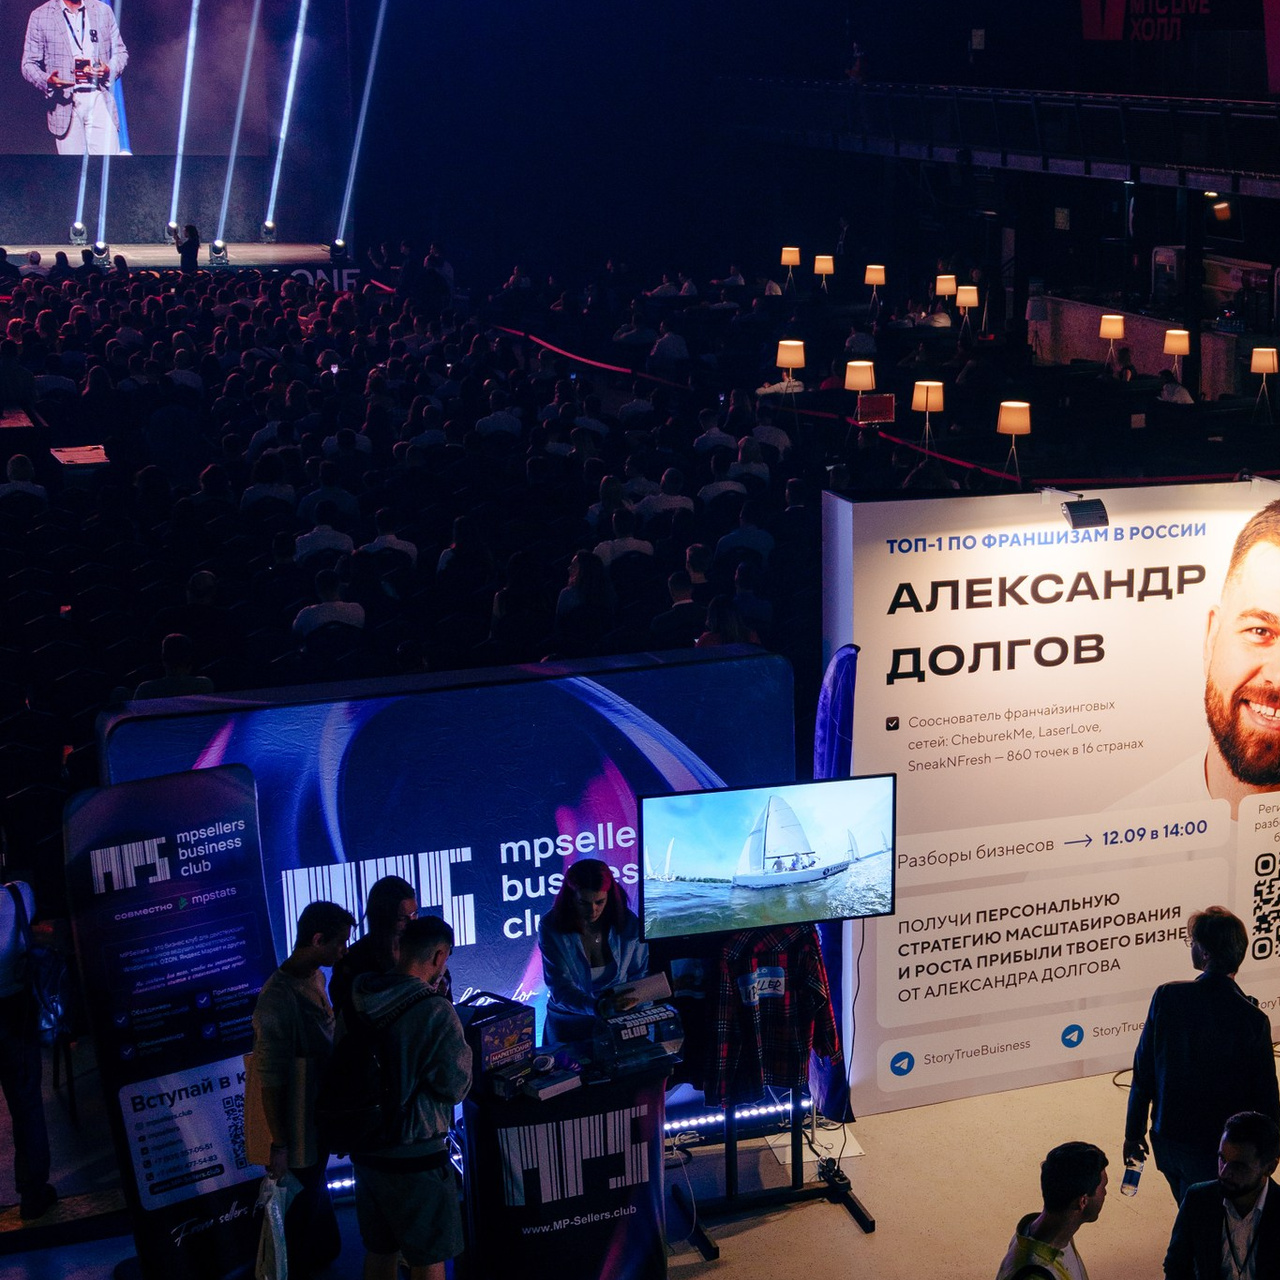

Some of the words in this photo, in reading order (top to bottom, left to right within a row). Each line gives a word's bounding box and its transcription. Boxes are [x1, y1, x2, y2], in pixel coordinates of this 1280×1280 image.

[1130, 16, 1182, 41] ХОЛЛ
[886, 536, 943, 555] ТОП-1
[948, 535, 977, 551] ПО
[981, 528, 1108, 549] ФРАНШИЗАМ
[1114, 526, 1125, 541] В
[1129, 522, 1207, 540] РОССИИ
[886, 564, 1207, 616] АЛЕКСАНДР
[886, 633, 1107, 686] ДОЛГОВ
[908, 711, 1002, 730] Сооснователь
[1003, 700, 1116, 723] франчайзинговых
[907, 735, 949, 751] сетей:
[951, 728, 1036, 747] CheburekMe,
[1038, 722, 1102, 739] LaserLove,
[907, 754, 992, 773] SneakNFresh
[1006, 748, 1032, 762] 860
[1034, 747, 1070, 760] точек
[1072, 745, 1079, 755] в
[1081, 742, 1094, 755] 16
[1096, 739, 1145, 756] странах
[176, 819, 246, 846] mpsellers
[500, 822, 637, 869] mpselle
[897, 849, 972, 872] Разборы
[975, 839, 1055, 860] бизнесов
[1102, 827, 1147, 846] 12.09
[1150, 829, 1159, 840] в
[1162, 820, 1208, 839] 14:00
[178, 837, 243, 862] business
[181, 859, 212, 878] club
[191, 886, 237, 907] mpstats
[898, 912, 971, 934] ПОЛУЧИ
[975, 892, 1120, 925] ПЕРСОНАЛЬНУЮ
[898, 931, 1002, 958] СТРАТЕГИЮ
[1006, 906, 1182, 943] МАСШТАБИРОВАНИЯ
[898, 966, 911, 980] И
[915, 958, 972, 978] РОСТА
[977, 945, 1063, 970] ПРИБЫЛИ
[1065, 935, 1131, 957] ТВОЕГО
[1134, 926, 1188, 947] БИЗНЕ
[898, 987, 921, 1002] ОТ
[924, 970, 1038, 999] АЛЕКСАНДРА
[1040, 958, 1121, 985] ДОЛГОВА
[620, 1024, 648, 1041] CLUB
[1093, 1020, 1146, 1039] StoryTrue
[923, 1038, 1031, 1066] StoryTrueBuisness
[131, 1078, 214, 1113] Вступай
[219, 1076, 231, 1090] в
[522, 1205, 637, 1235] www.MP-Sellers.club
